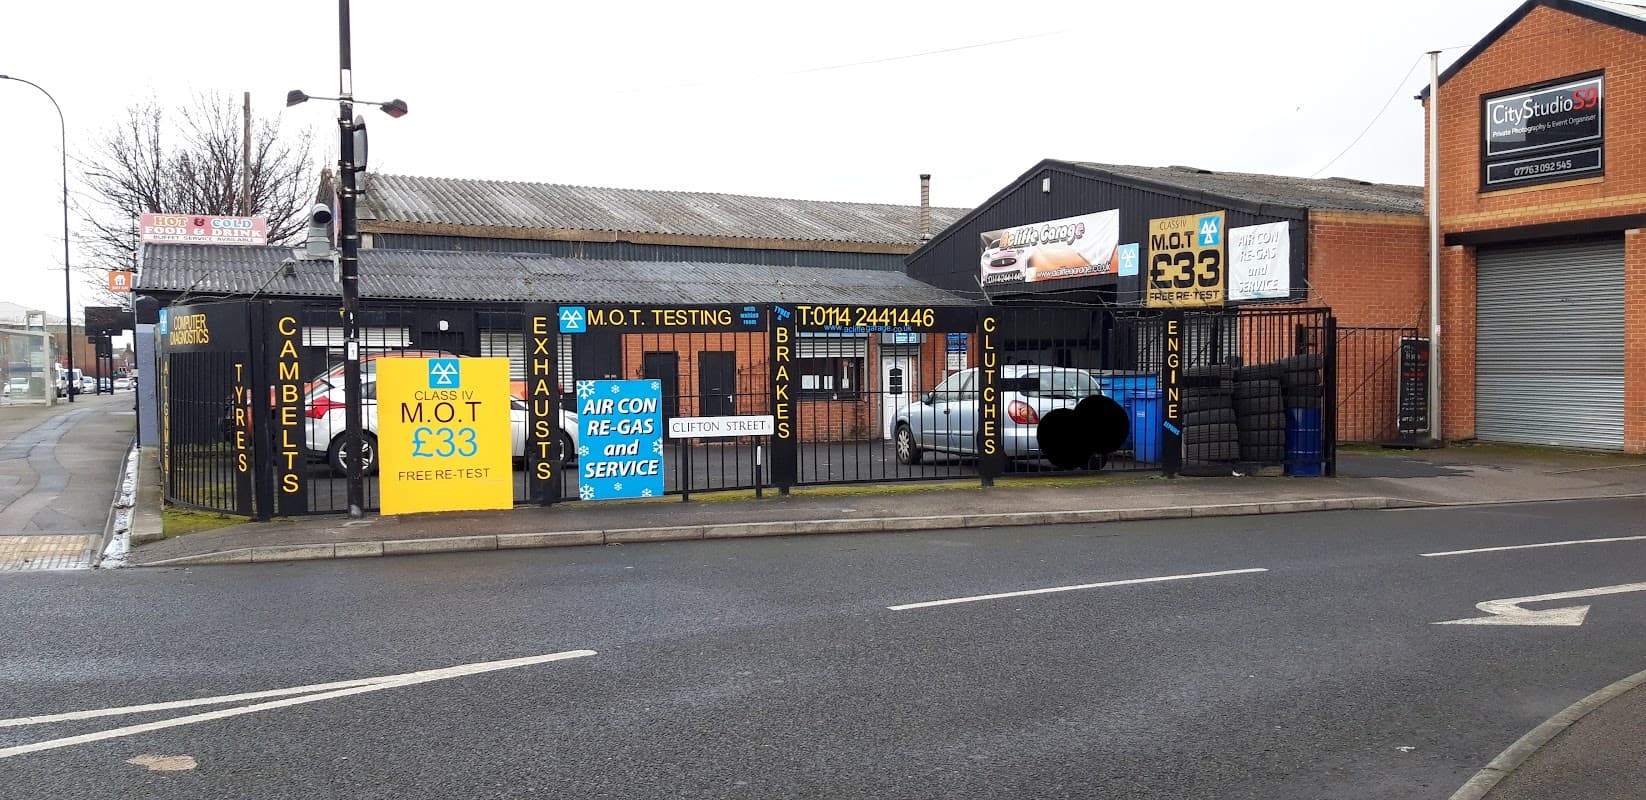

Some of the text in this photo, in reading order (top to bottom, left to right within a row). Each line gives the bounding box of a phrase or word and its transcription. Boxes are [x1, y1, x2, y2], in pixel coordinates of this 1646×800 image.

[1512, 123, 1546, 135] Photography
[1552, 119, 1568, 128] Event
[1569, 114, 1597, 125] Organiser
[1514, 160, 1572, 176] 07763 092 545
[155, 216, 252, 228] HOT & COLD
[1160, 219, 1187, 231] CLASS IV
[211, 229, 261, 237] DRINK
[1039, 222, 1086, 245] Garage
[1152, 231, 1194, 251] M.O.T
[1239, 231, 1279, 247] AIR CON
[1240, 248, 1277, 262] RE-GAS
[1151, 249, 1220, 289] £33
[1248, 264, 1267, 276] and
[1239, 279, 1279, 293] SERVICE
[1150, 290, 1220, 301] FREE RE-TEST
[174, 314, 207, 330] COMPUTER
[652, 310, 732, 326] TESTING
[855, 308, 935, 327] 2441446
[170, 329, 210, 345] DIAGNOSTICS
[1167, 320, 1179, 419] ENGINE
[775, 327, 790, 439] BRAKES
[983, 317, 996, 455] CLUTCHES
[414, 390, 474, 401] CLASS IV
[533, 316, 551, 480] EXHAUSTS
[278, 316, 299, 493] CAMBELTS
[401, 401, 482, 423] M.O.T
[582, 398, 657, 415] AIR CON
[235, 363, 247, 472] TYRES
[587, 419, 654, 436] RE-GAS
[672, 422, 720, 433] CLIFTON
[726, 420, 765, 431] STREET
[412, 427, 478, 457] £33
[604, 439, 639, 457] and
[398, 467, 490, 481] FREE RE-TEST
[584, 460, 659, 479] SERVICE
